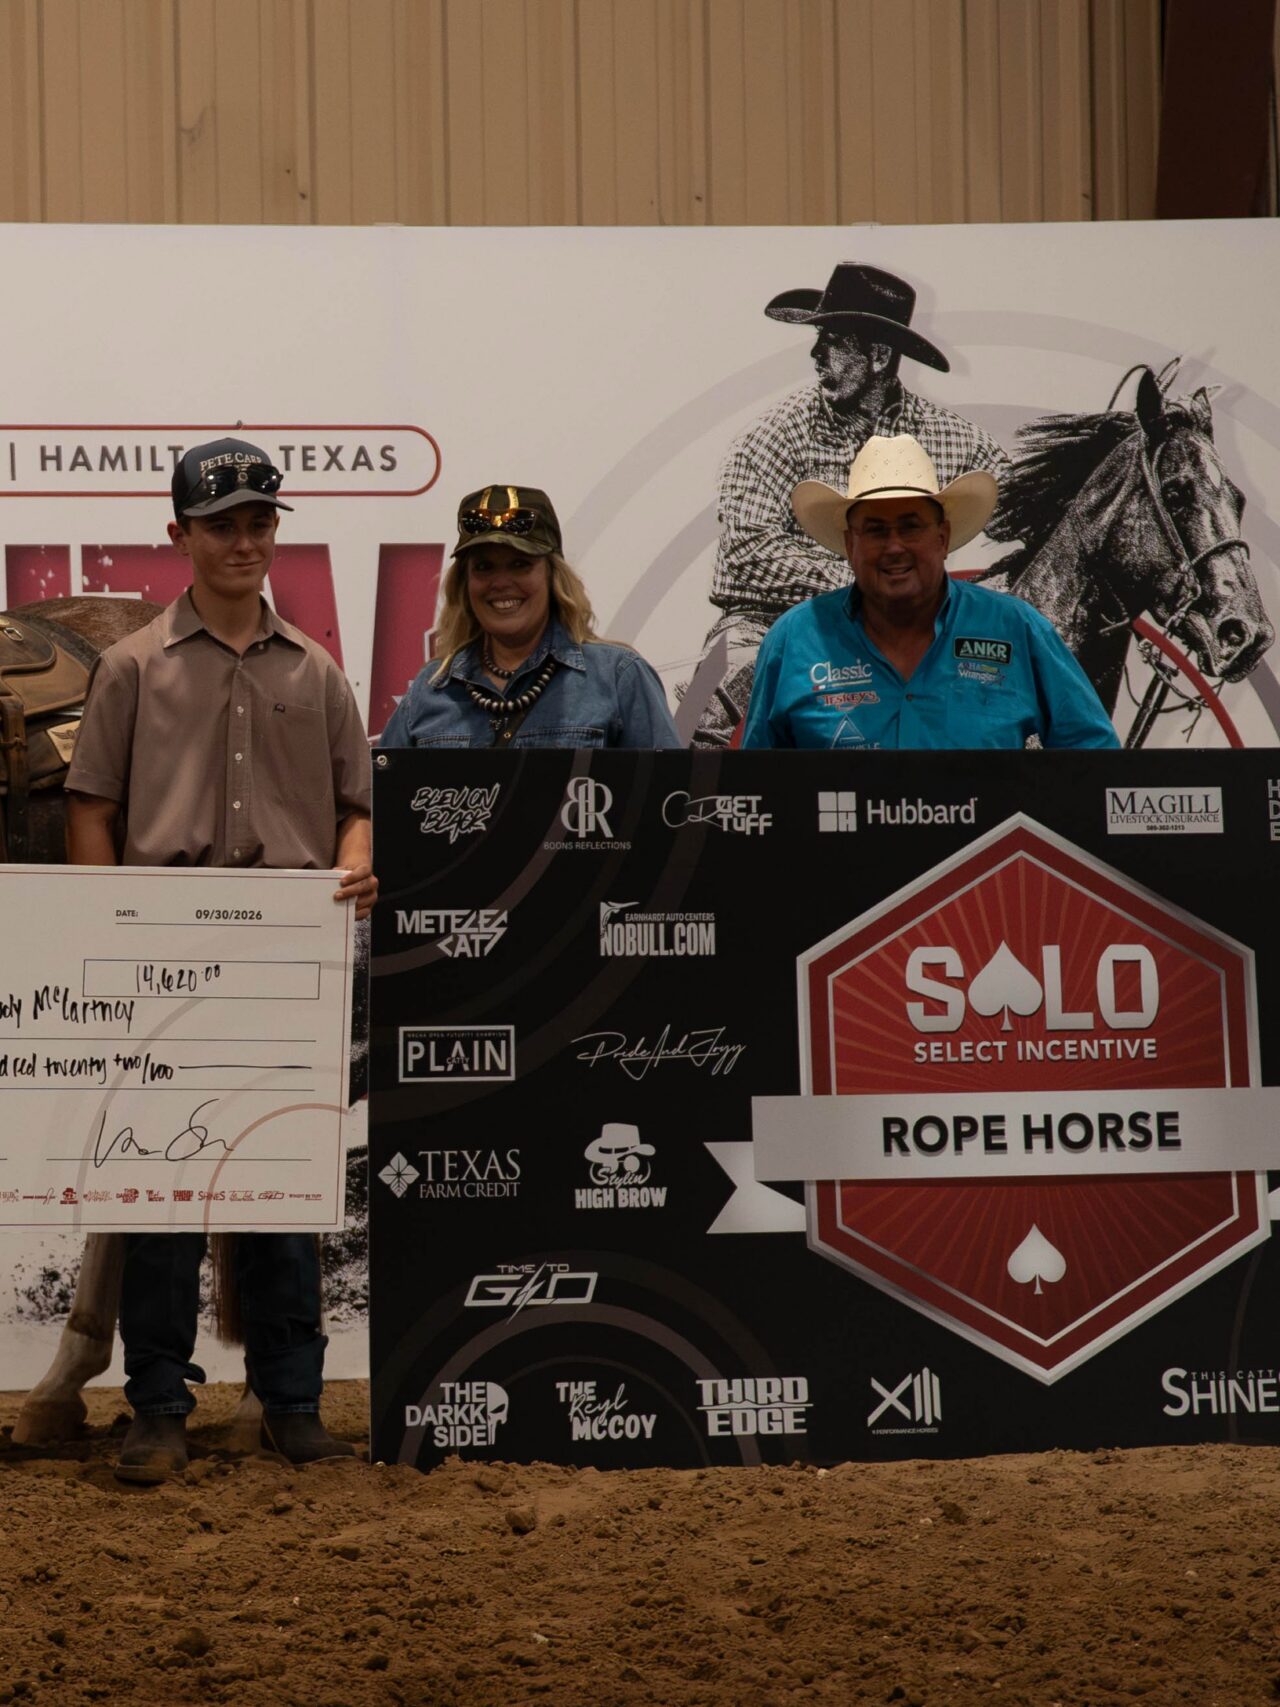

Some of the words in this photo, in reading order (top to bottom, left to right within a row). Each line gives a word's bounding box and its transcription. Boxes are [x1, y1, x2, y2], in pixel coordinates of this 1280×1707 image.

[39, 445, 184, 472] HAMILT
[279, 445, 398, 472] TEXAS
[199, 452, 234, 471] PETE
[959, 640, 1008, 659] ANKR
[809, 658, 873, 684] Classic
[716, 795, 763, 817] GET
[866, 797, 976, 825] Hubbard
[1109, 791, 1220, 815] MAGILL
[420, 809, 492, 845] BLACK
[716, 813, 773, 835] TUFF
[1109, 814, 1163, 824] LIVESTOCK
[1164, 814, 1220, 823] INSURANCE
[543, 841, 574, 850] BOONS
[575, 841, 632, 850] REFLECTIONS
[115, 909, 139, 918] DATE:
[195, 909, 263, 921] 09/30/2026
[624, 912, 665, 922] EARNHARDT
[666, 912, 685, 922] AUTO
[685, 912, 716, 921] CENTERS
[600, 922, 716, 956] NOBULL.COM
[407, 1040, 507, 1072] PLAIN
[913, 1039, 1009, 1064] SELECT
[1016, 1037, 1160, 1062] INCENTIVE
[43, 1054, 107, 1085] twenty
[881, 1114, 1009, 1156] ROPE
[1022, 1111, 1182, 1153] HORSE
[417, 1149, 521, 1181] TEXAS
[419, 1182, 461, 1199] FARM
[464, 1182, 521, 1198] CREDIT
[574, 1188, 615, 1209] HIGH
[617, 1187, 668, 1208] BROW
[496, 1264, 536, 1273] TIME
[546, 1263, 570, 1272] TO
[1190, 1371, 1226, 1380] THIS
[1236, 1369, 1280, 1380] CATT
[439, 1382, 486, 1403] THE
[555, 1381, 597, 1403] THE
[696, 1376, 809, 1404] THIRD
[1161, 1367, 1280, 1416] SHINE
[405, 1403, 487, 1427] DARKK
[705, 1408, 809, 1436] EDGE
[433, 1425, 488, 1447] SIDE
